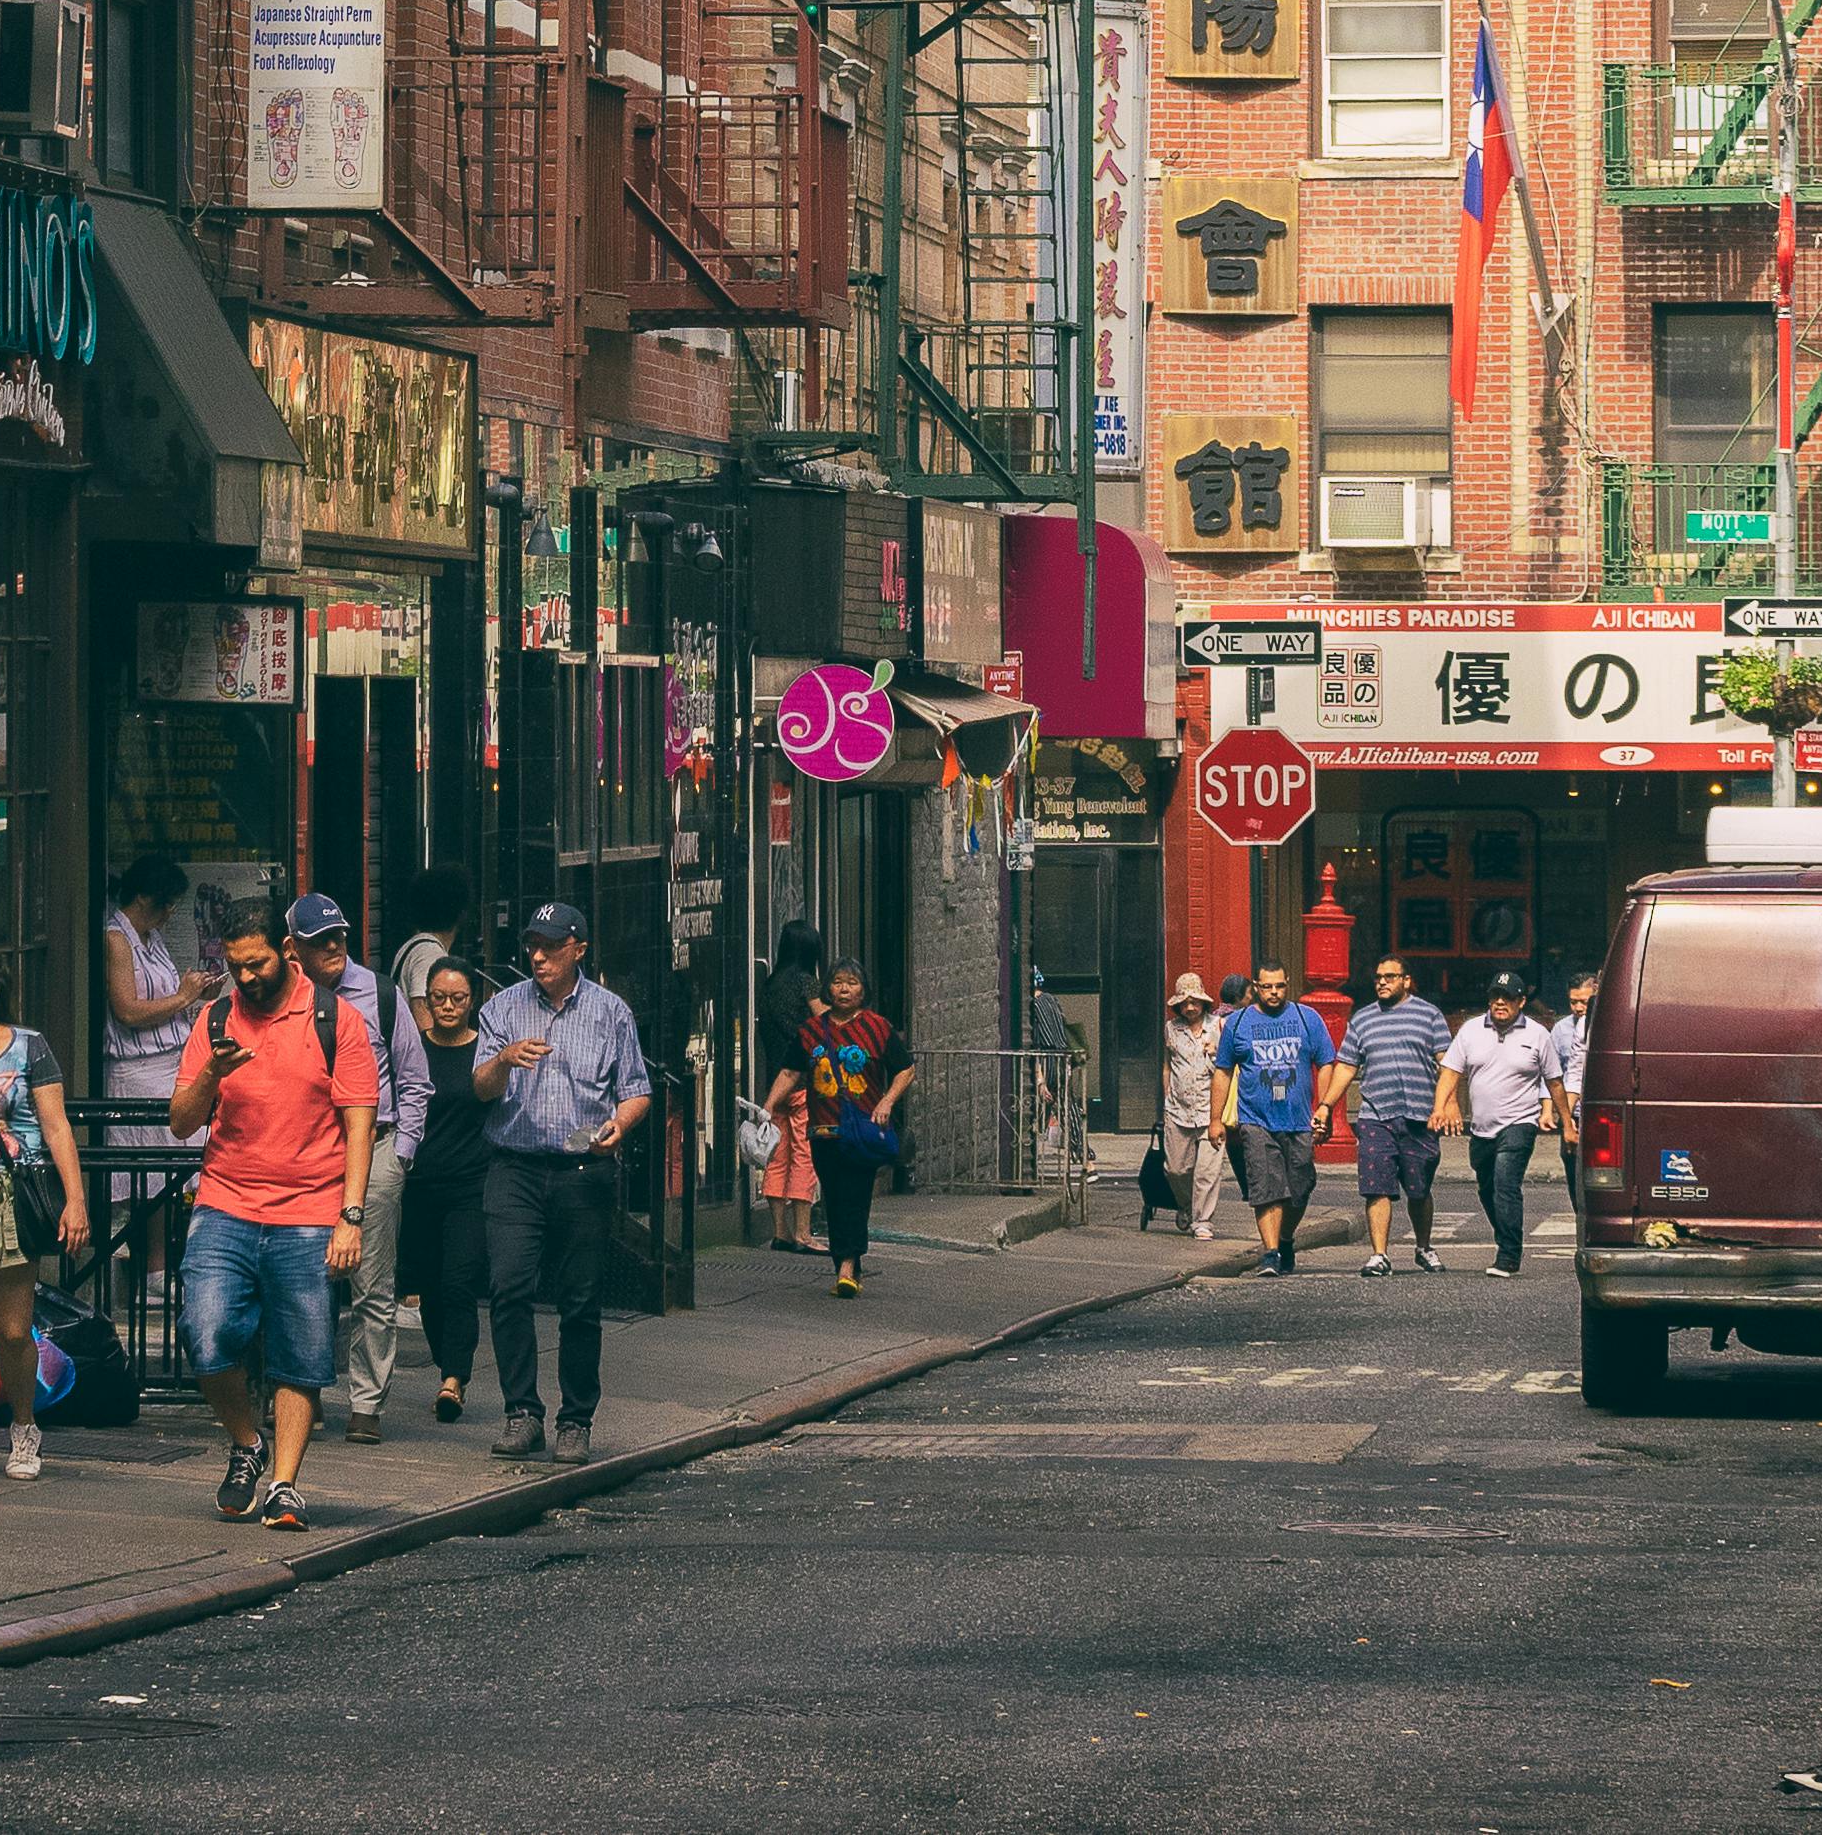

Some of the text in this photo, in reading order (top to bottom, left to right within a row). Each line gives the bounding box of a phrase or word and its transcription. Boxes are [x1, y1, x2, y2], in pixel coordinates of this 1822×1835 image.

[254, 4, 373, 25] Japanese Straight Perm
[254, 29, 382, 50] Acupressure Acupuncture
[253, 53, 336, 74] Foot Reflexology
[1093, 432, 1126, 455] 9-0818
[1701, 514, 1741, 531] MOTT
[1286, 609, 1516, 628] MUNCHIES PARADISE
[1592, 607, 1696, 629] AJI ICHIBAN
[1742, 610, 1777, 627] ONE
[1201, 633, 1311, 653] ONE WAY
[988, 670, 1016, 681] ANYTIME
[1619, 750, 1636, 761] 37
[1717, 749, 1746, 764] Toll
[1750, 749, 1775, 764] Fre
[1204, 763, 1306, 808] STOP
[1042, 795, 1148, 820] Yung Benevolent
[1033, 820, 1111, 842] iation, Inc.
[1253, 1044, 1301, 1062] NOW
